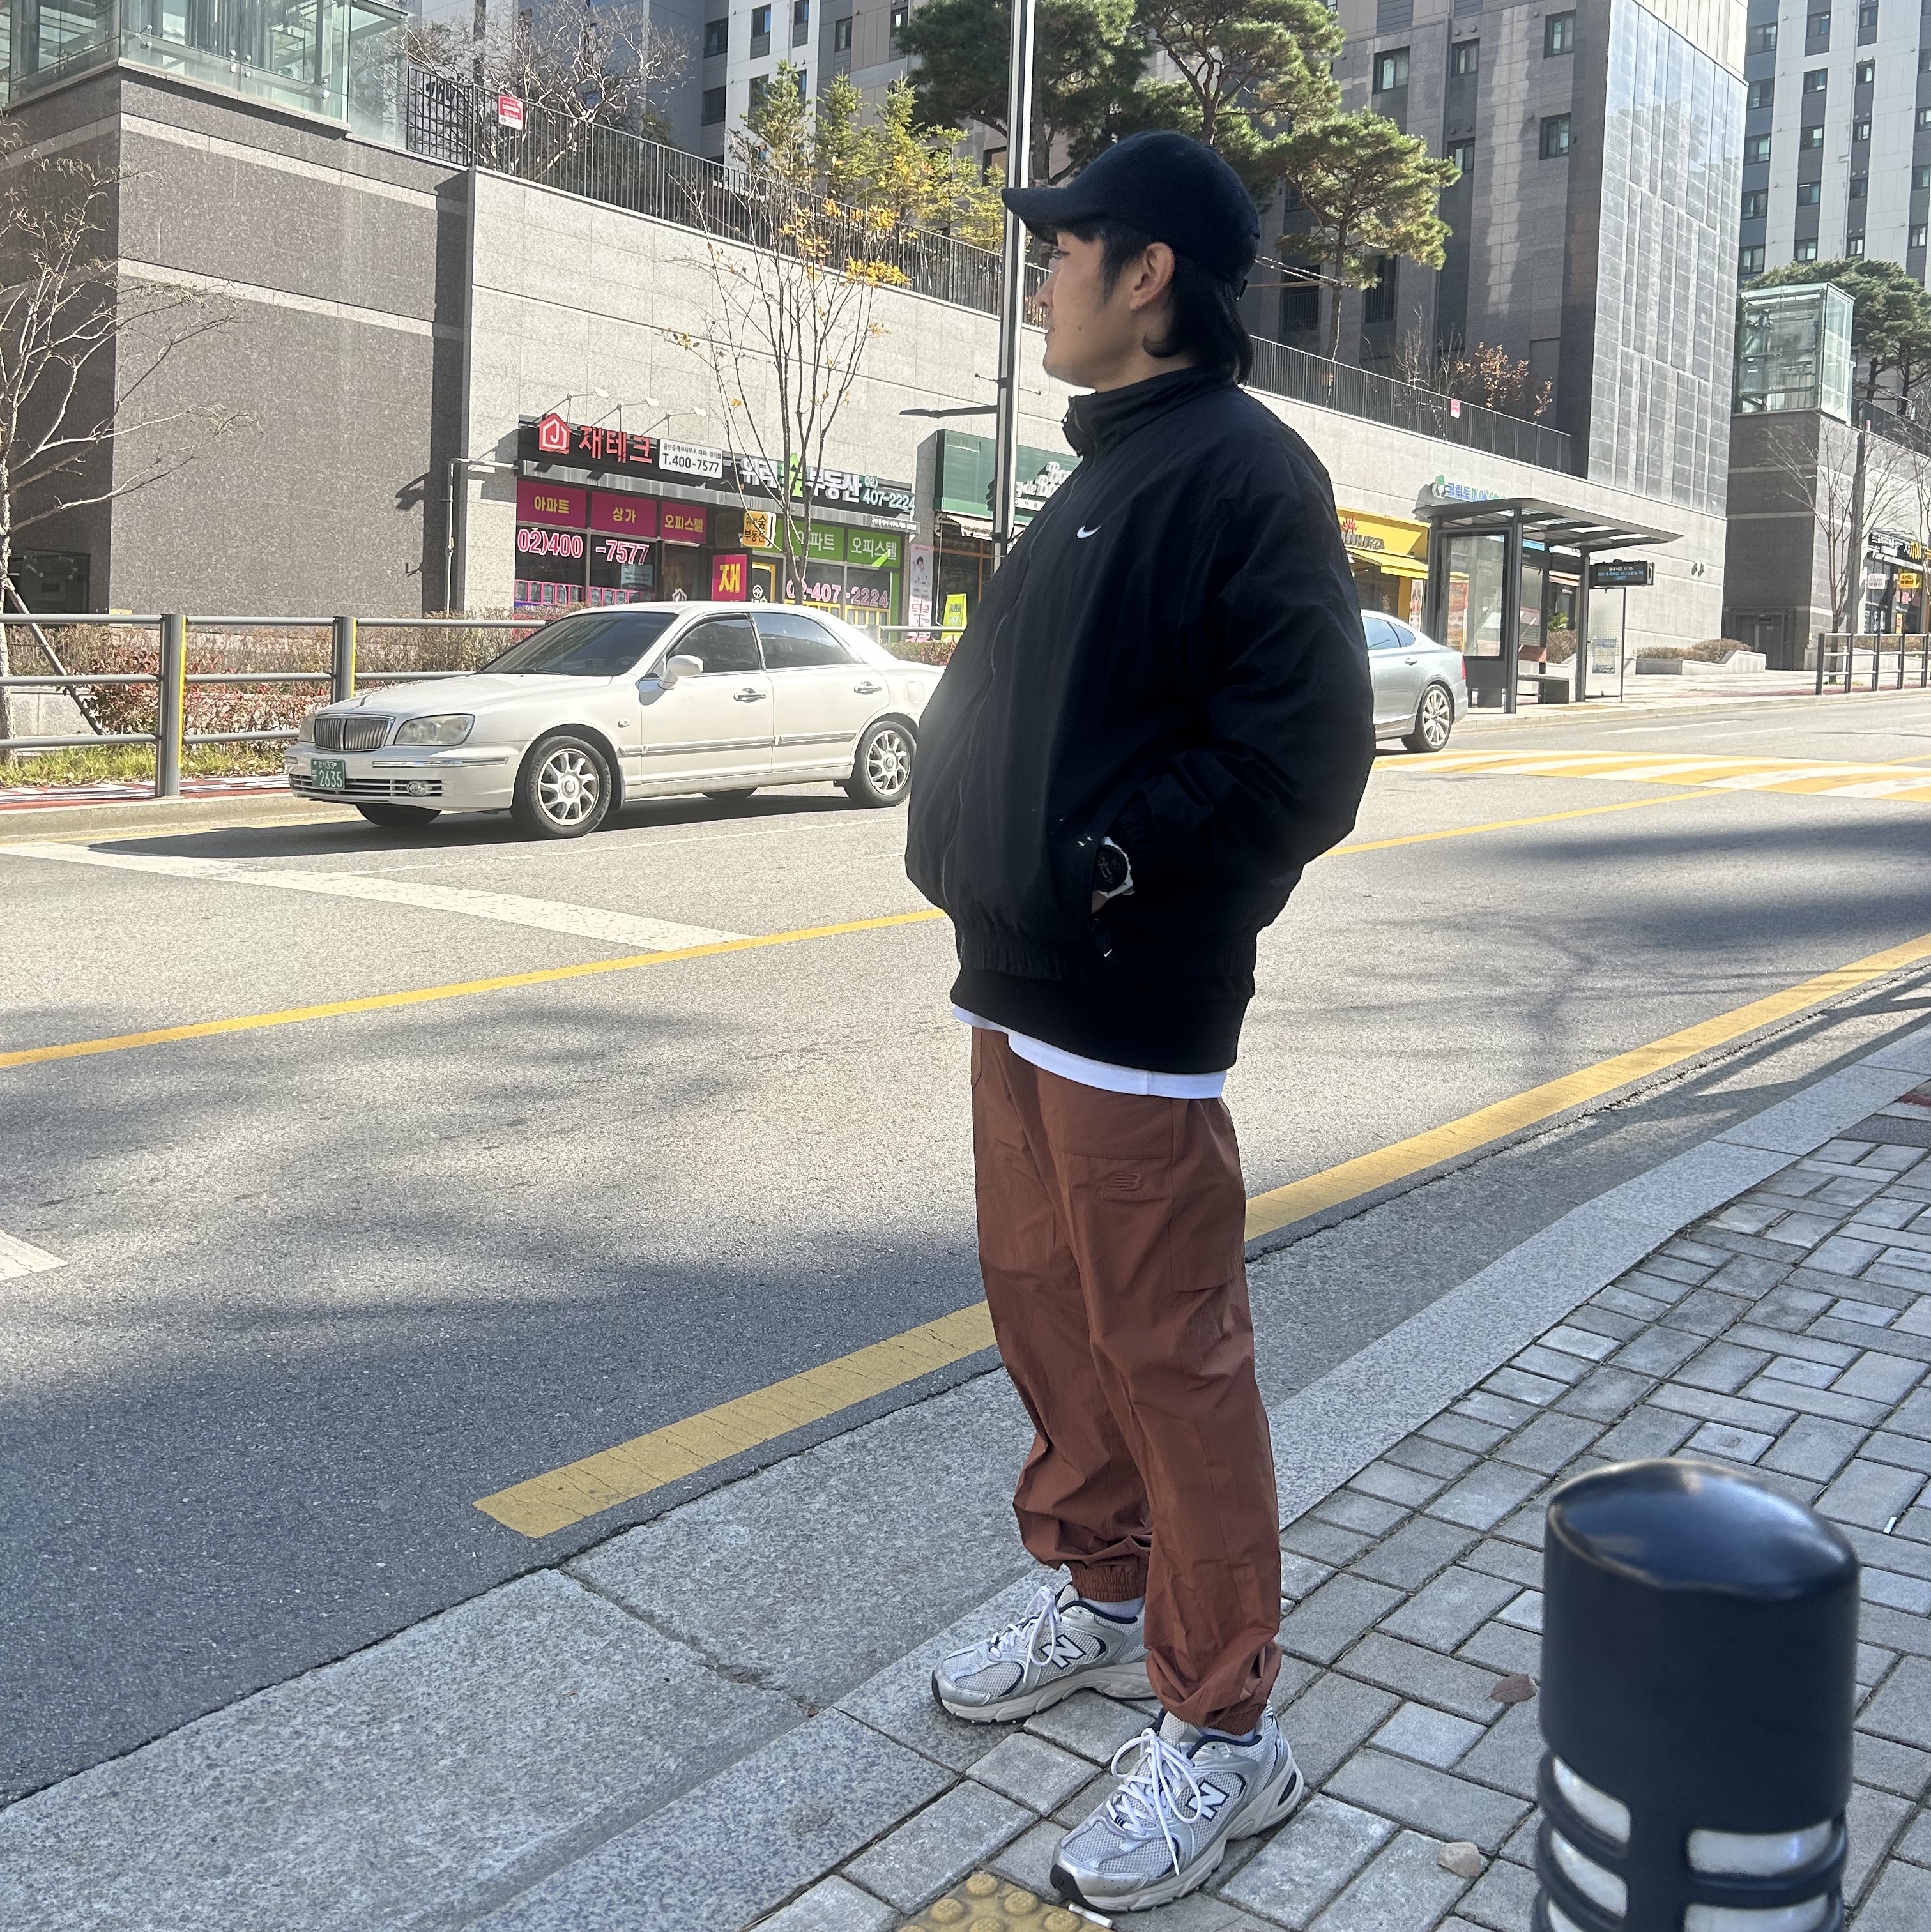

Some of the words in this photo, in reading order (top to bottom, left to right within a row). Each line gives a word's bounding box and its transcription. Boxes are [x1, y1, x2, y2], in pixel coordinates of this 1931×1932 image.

[578, 425, 652, 464] 재테크
[662, 453, 719, 473] T.400-7577
[534, 495, 570, 515] 아파트
[862, 490, 916, 511] 407-2224
[613, 507, 636, 524] 상가
[664, 514, 703, 533] 오피스텔
[744, 529, 765, 543] 부동산
[851, 536, 897, 561] 오피스텔
[719, 563, 740, 593] 재
[319, 770, 342, 788] 2635
[1039, 1634, 1086, 1670] N
[1184, 1779, 1229, 1822] N
